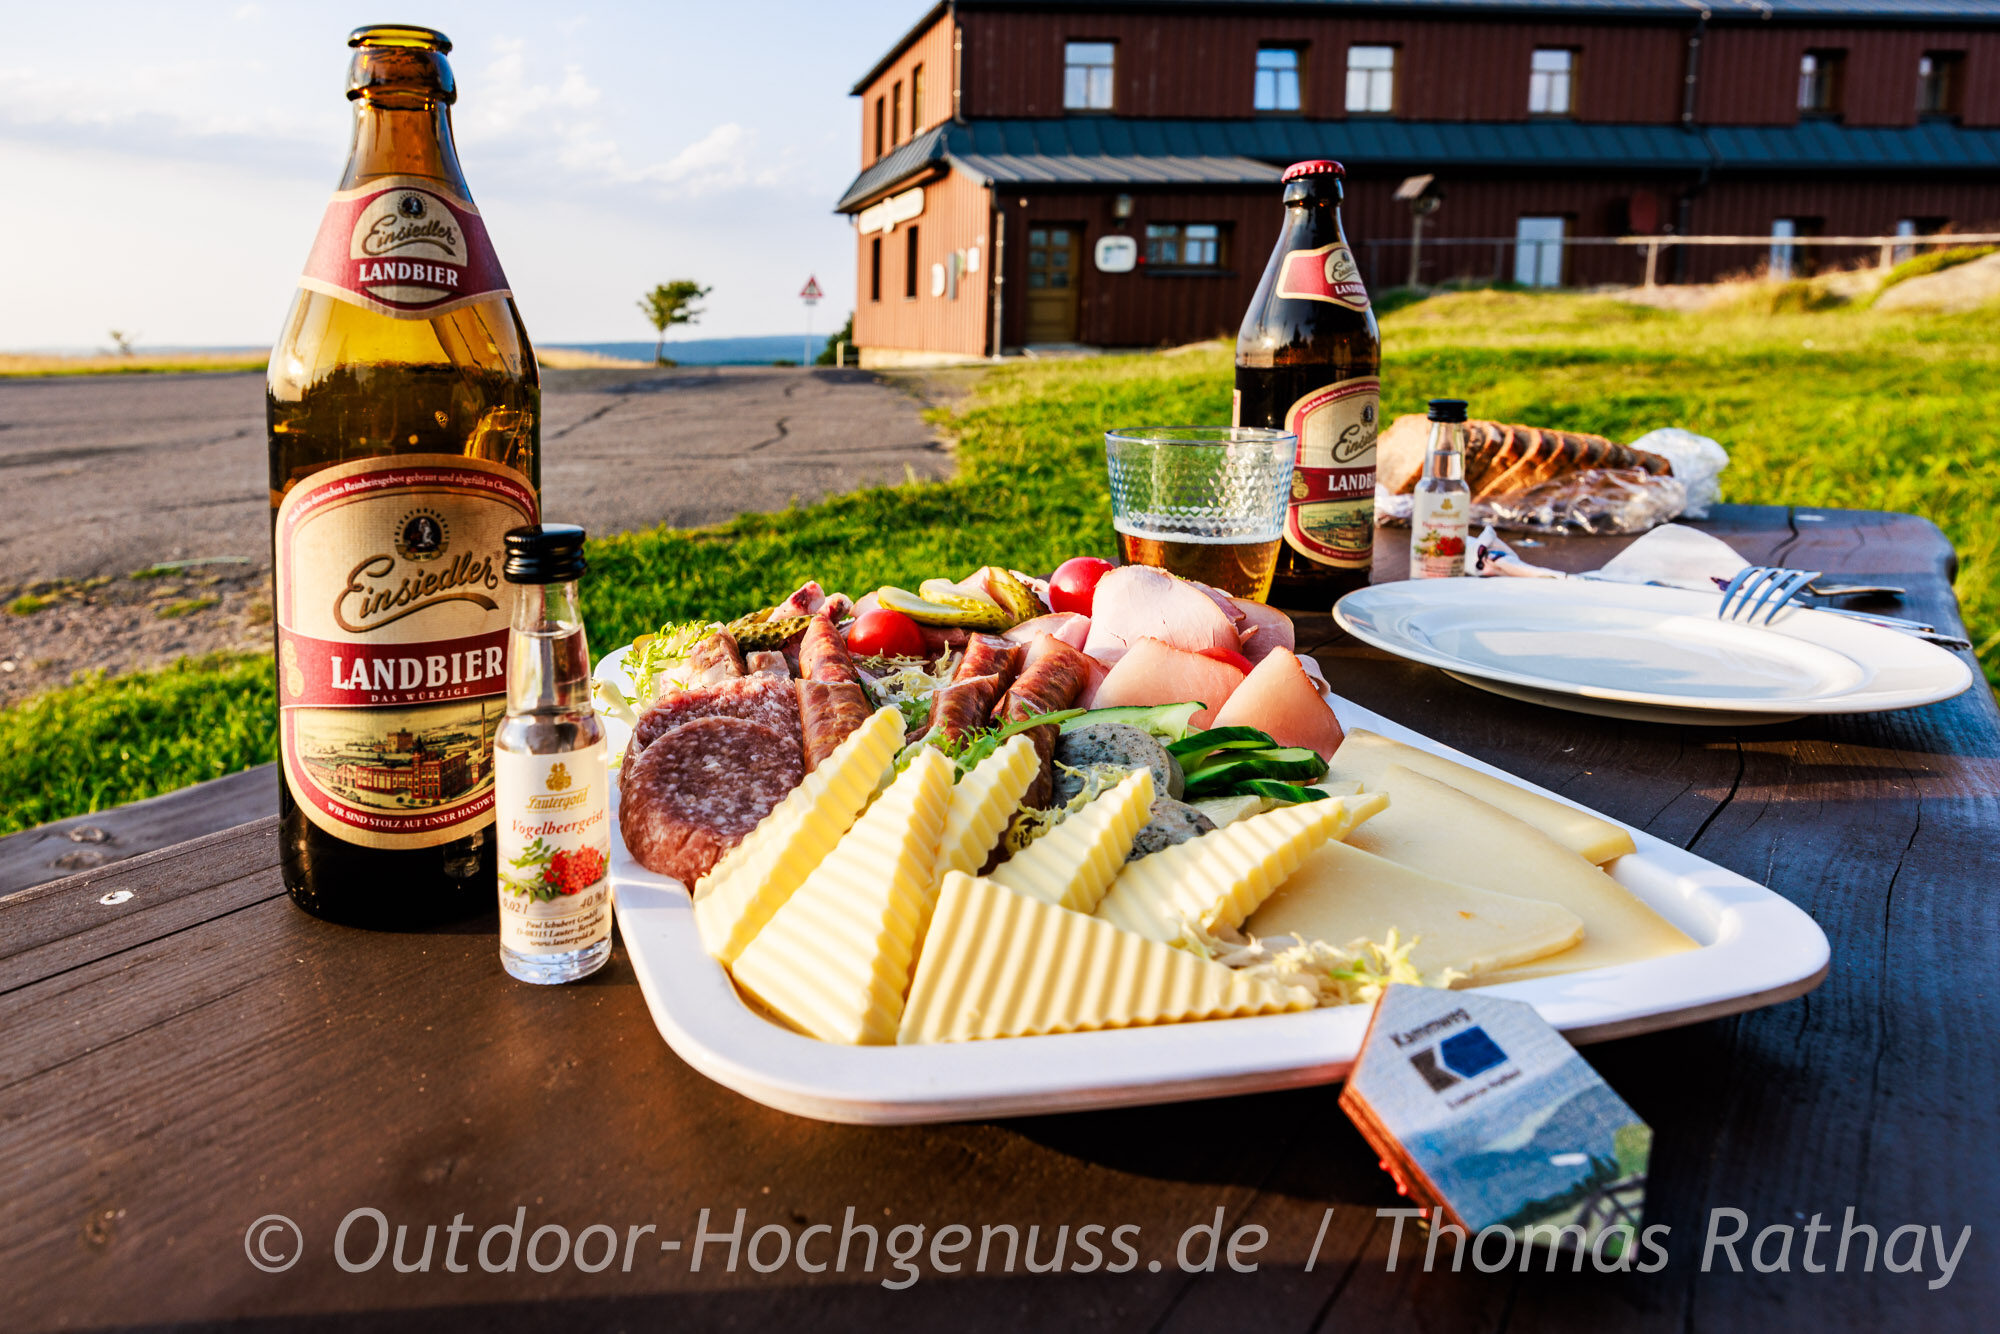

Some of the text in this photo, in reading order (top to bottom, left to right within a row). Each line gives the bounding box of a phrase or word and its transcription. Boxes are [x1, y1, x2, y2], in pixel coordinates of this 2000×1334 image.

[362, 214, 456, 256] Einsiedler
[358, 262, 458, 286] LANDBIER
[333, 551, 499, 634] Einsiedler
[331, 646, 504, 692] LANDBIER
[371, 686, 470, 703] DAS WÜRZIGE
[327, 801, 344, 817] WIR
[345, 811, 368, 825] SIND
[369, 817, 401, 829] STOLZ
[402, 820, 423, 830] AUF
[424, 812, 456, 827] UNSER
[512, 808, 604, 840] Vogelbeergeist
